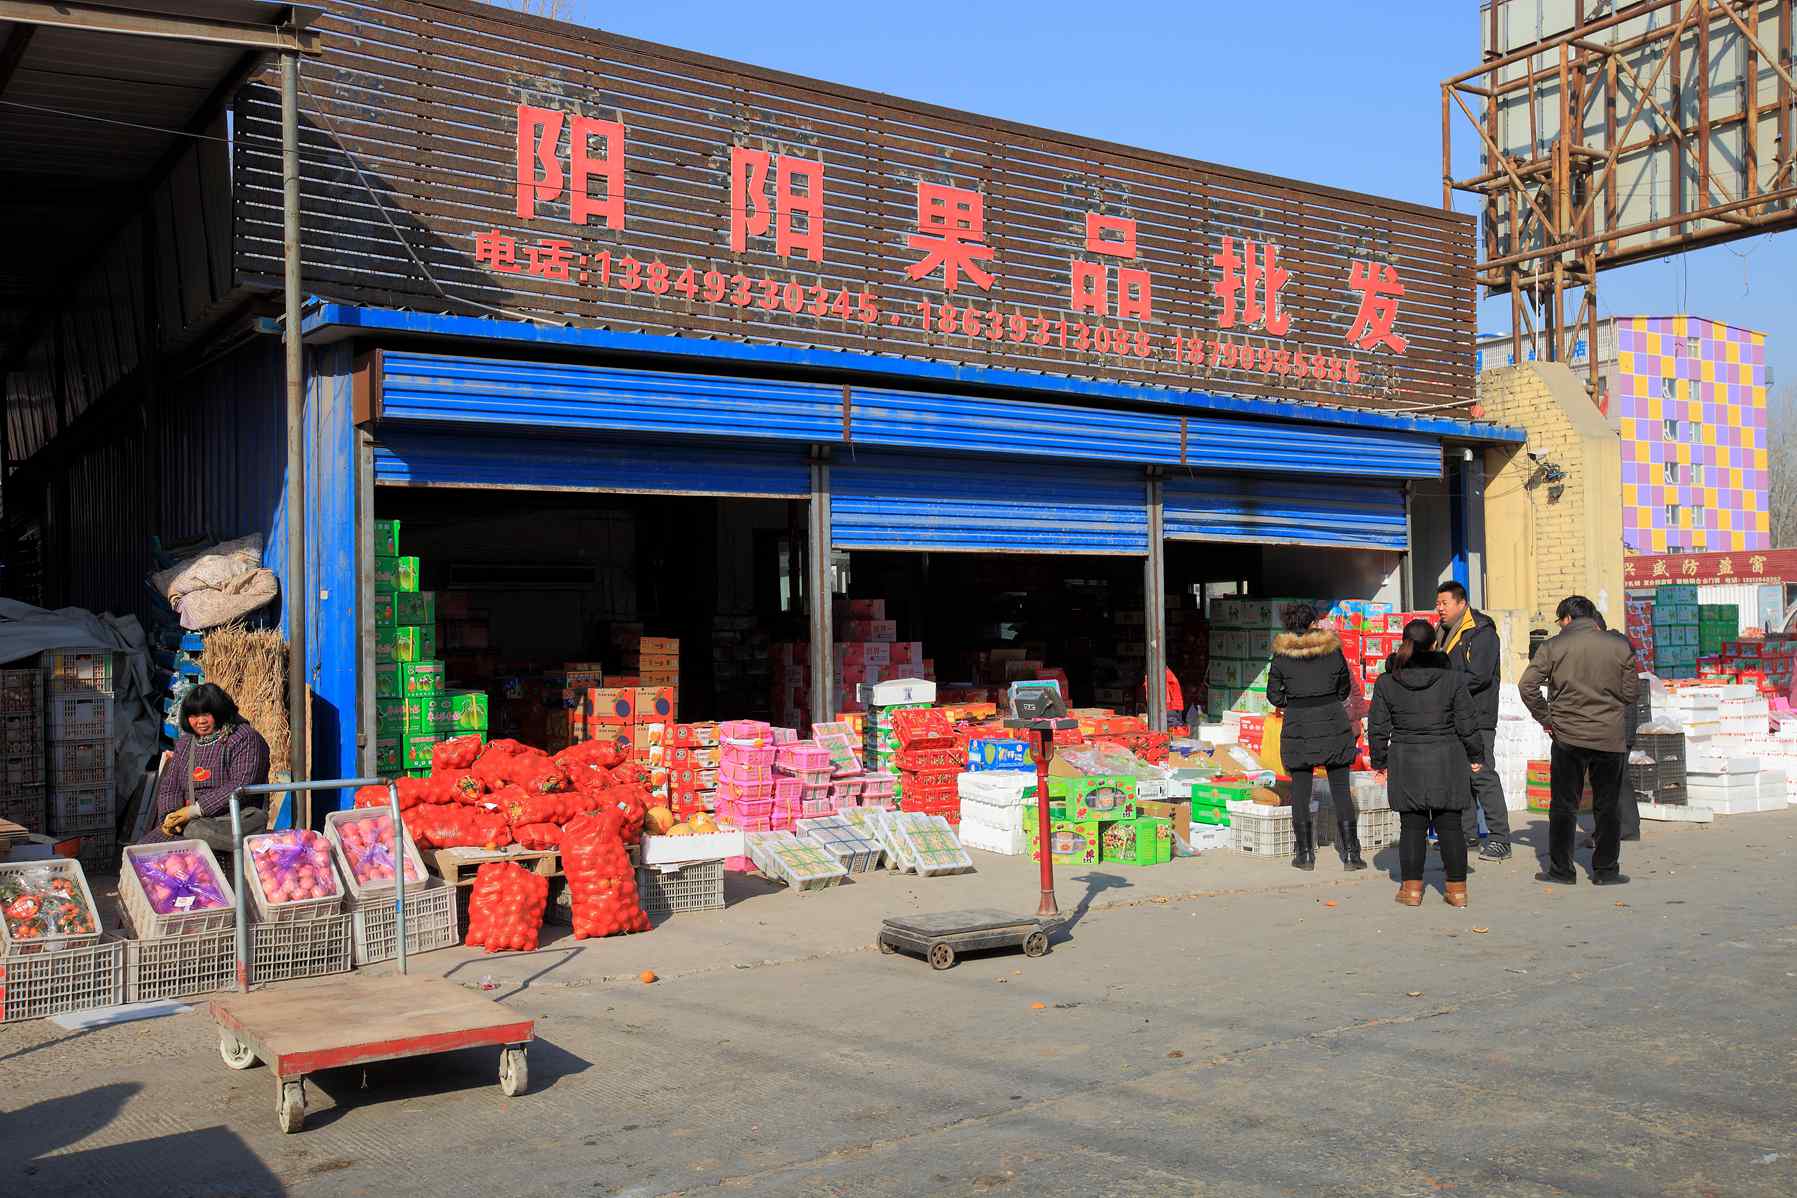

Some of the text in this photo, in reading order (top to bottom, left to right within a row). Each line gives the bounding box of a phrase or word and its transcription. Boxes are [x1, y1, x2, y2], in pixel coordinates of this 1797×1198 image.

[516, 105, 1409, 354] 阳阳果品批发
